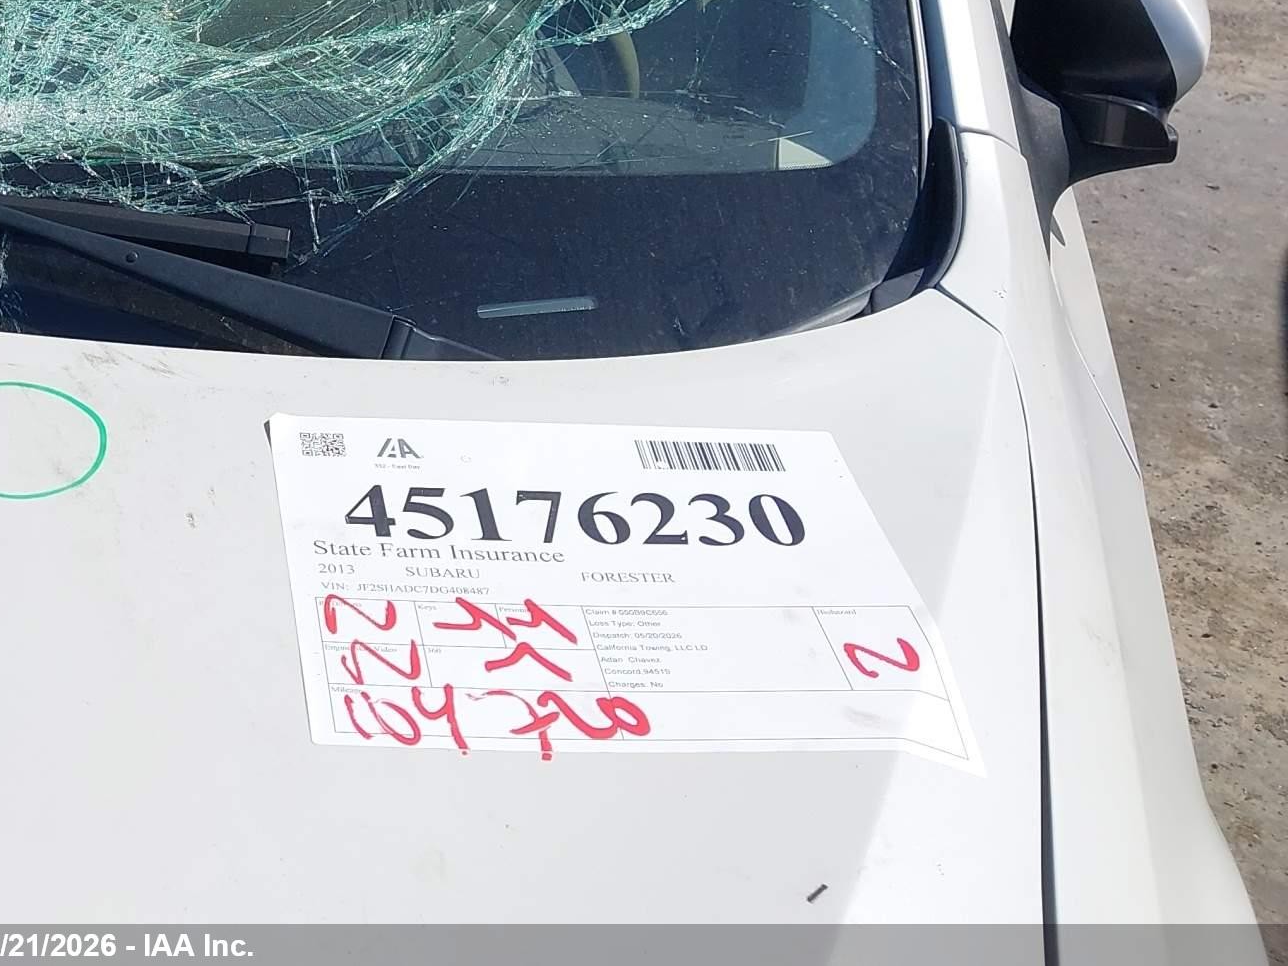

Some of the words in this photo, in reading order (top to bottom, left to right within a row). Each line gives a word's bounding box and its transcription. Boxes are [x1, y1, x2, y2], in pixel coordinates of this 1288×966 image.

[344, 484, 806, 547] 45176230
[313, 540, 371, 557] State
[379, 542, 441, 559] Farm
[449, 544, 565, 563] Insurance
[318, 563, 355, 575] 2013
[405, 566, 480, 579] SUBARU
[580, 571, 676, 584] FORESTER
[321, 582, 349, 592] VIN:
[585, 608, 609, 616] Claim
